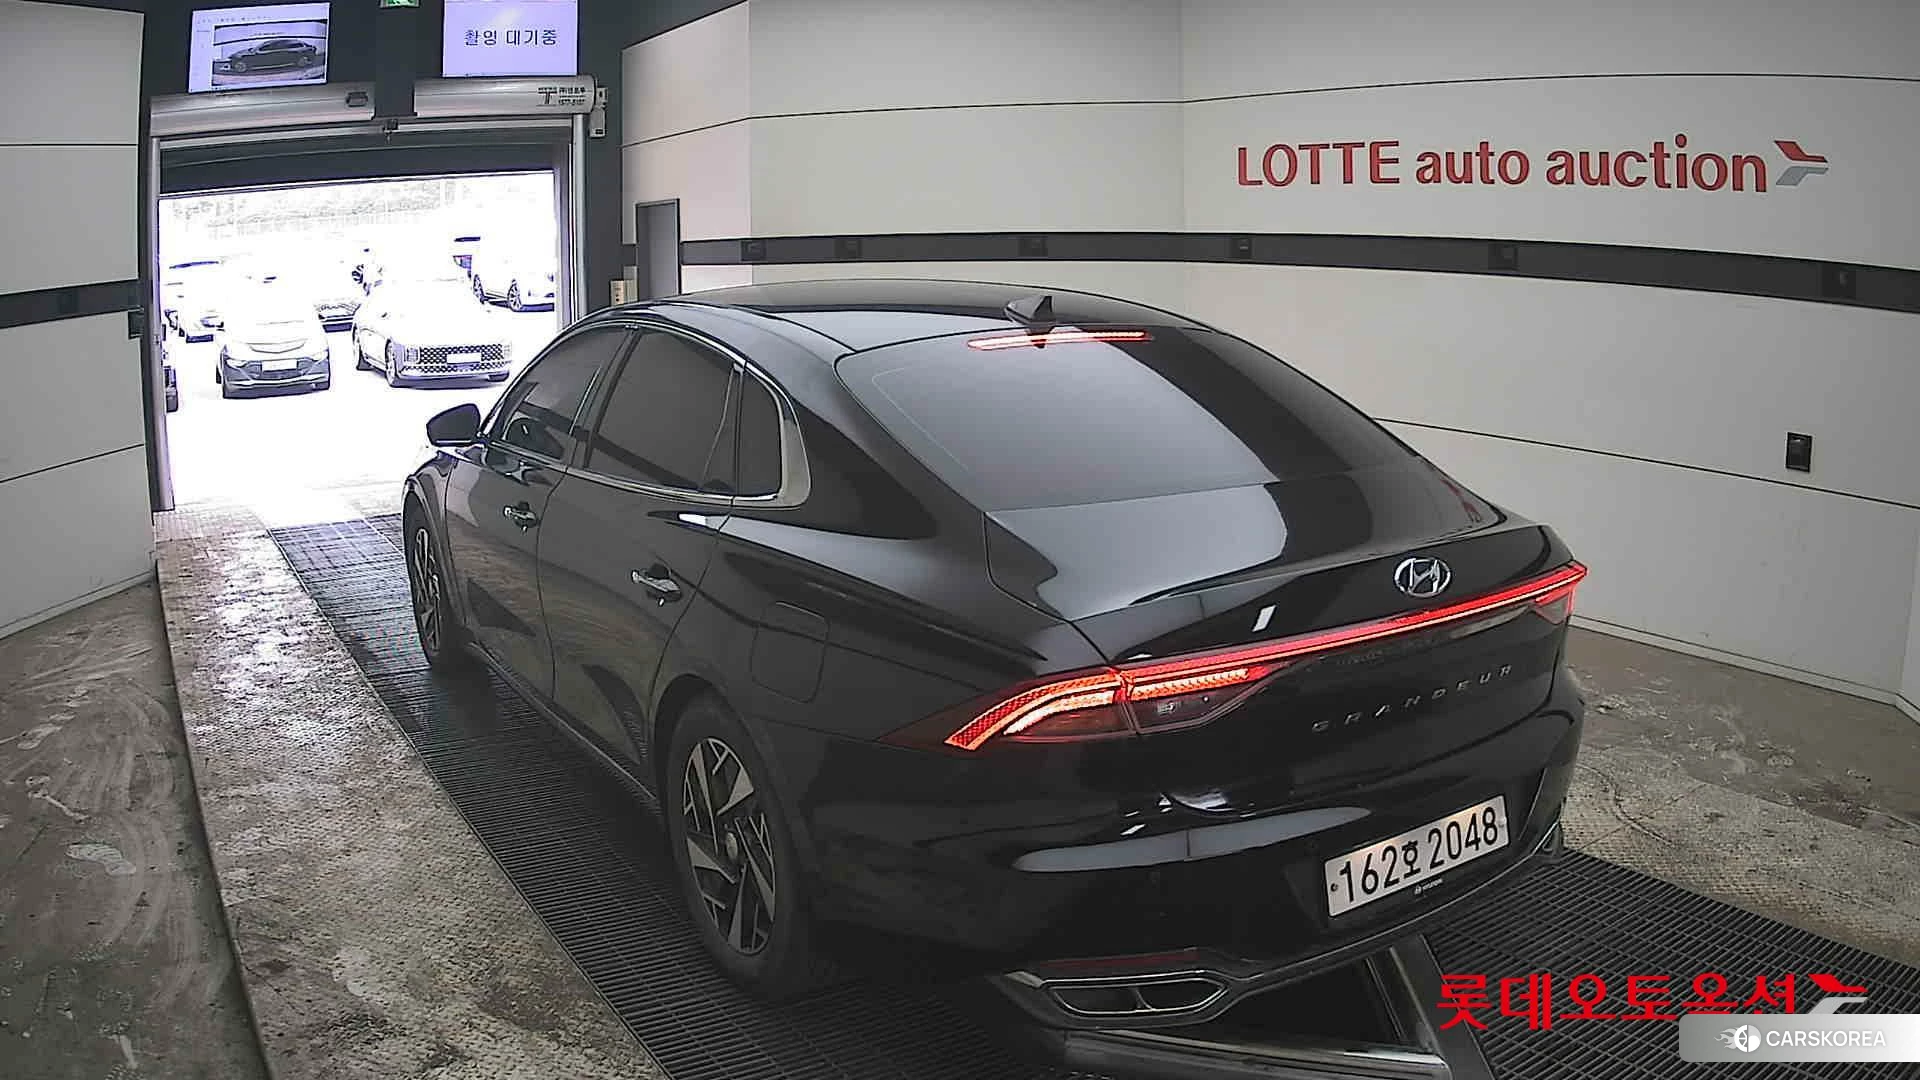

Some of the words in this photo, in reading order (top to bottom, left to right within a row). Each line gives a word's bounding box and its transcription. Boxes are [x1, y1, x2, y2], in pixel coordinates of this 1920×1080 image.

[506, 29, 557, 46] 대기중
[1238, 141, 1400, 186] LOTTE
[1416, 141, 1529, 185] auto
[1546, 134, 1767, 193] auction
[1311, 663, 1513, 733] GRANDEUR
[1428, 806, 1499, 870] 2048
